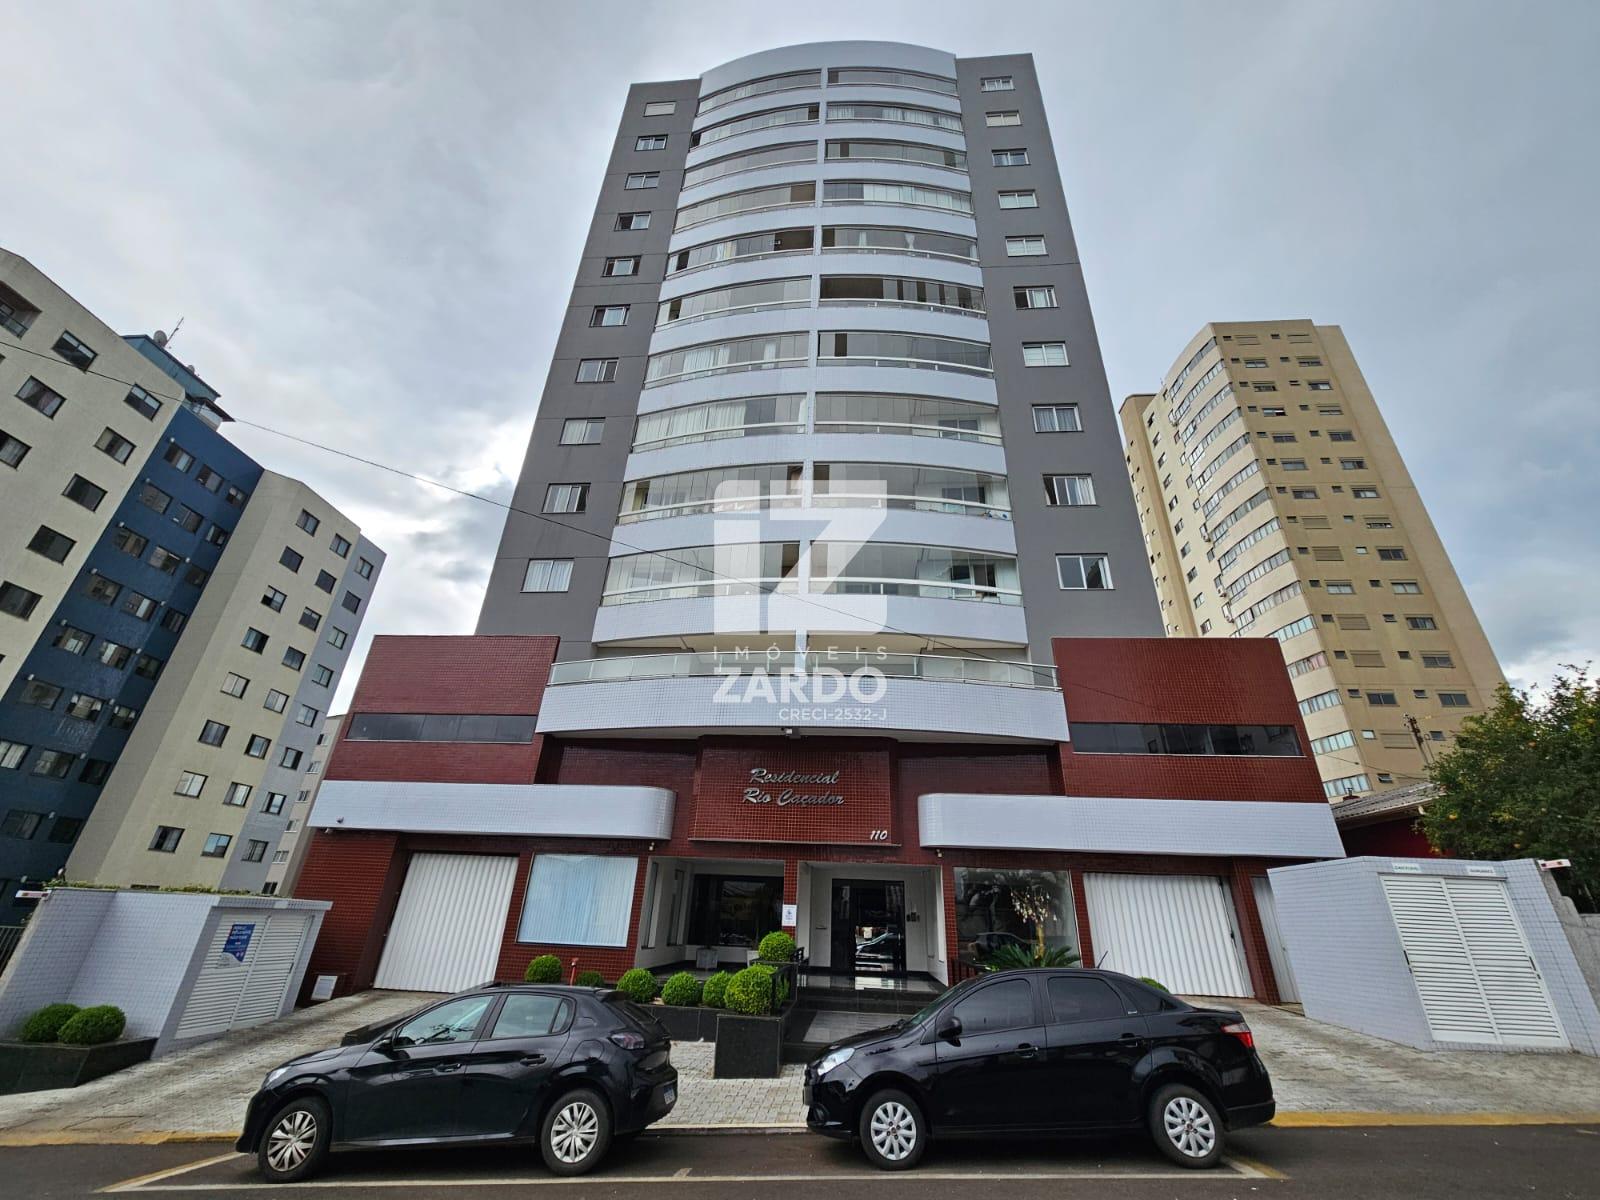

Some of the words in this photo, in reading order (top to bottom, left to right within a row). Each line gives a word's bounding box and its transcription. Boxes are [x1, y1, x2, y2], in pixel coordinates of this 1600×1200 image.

[750, 768, 840, 784] Residencial
[743, 787, 772, 804] Rio
[777, 788, 845, 807] Caçador
[870, 830, 888, 840] 110
